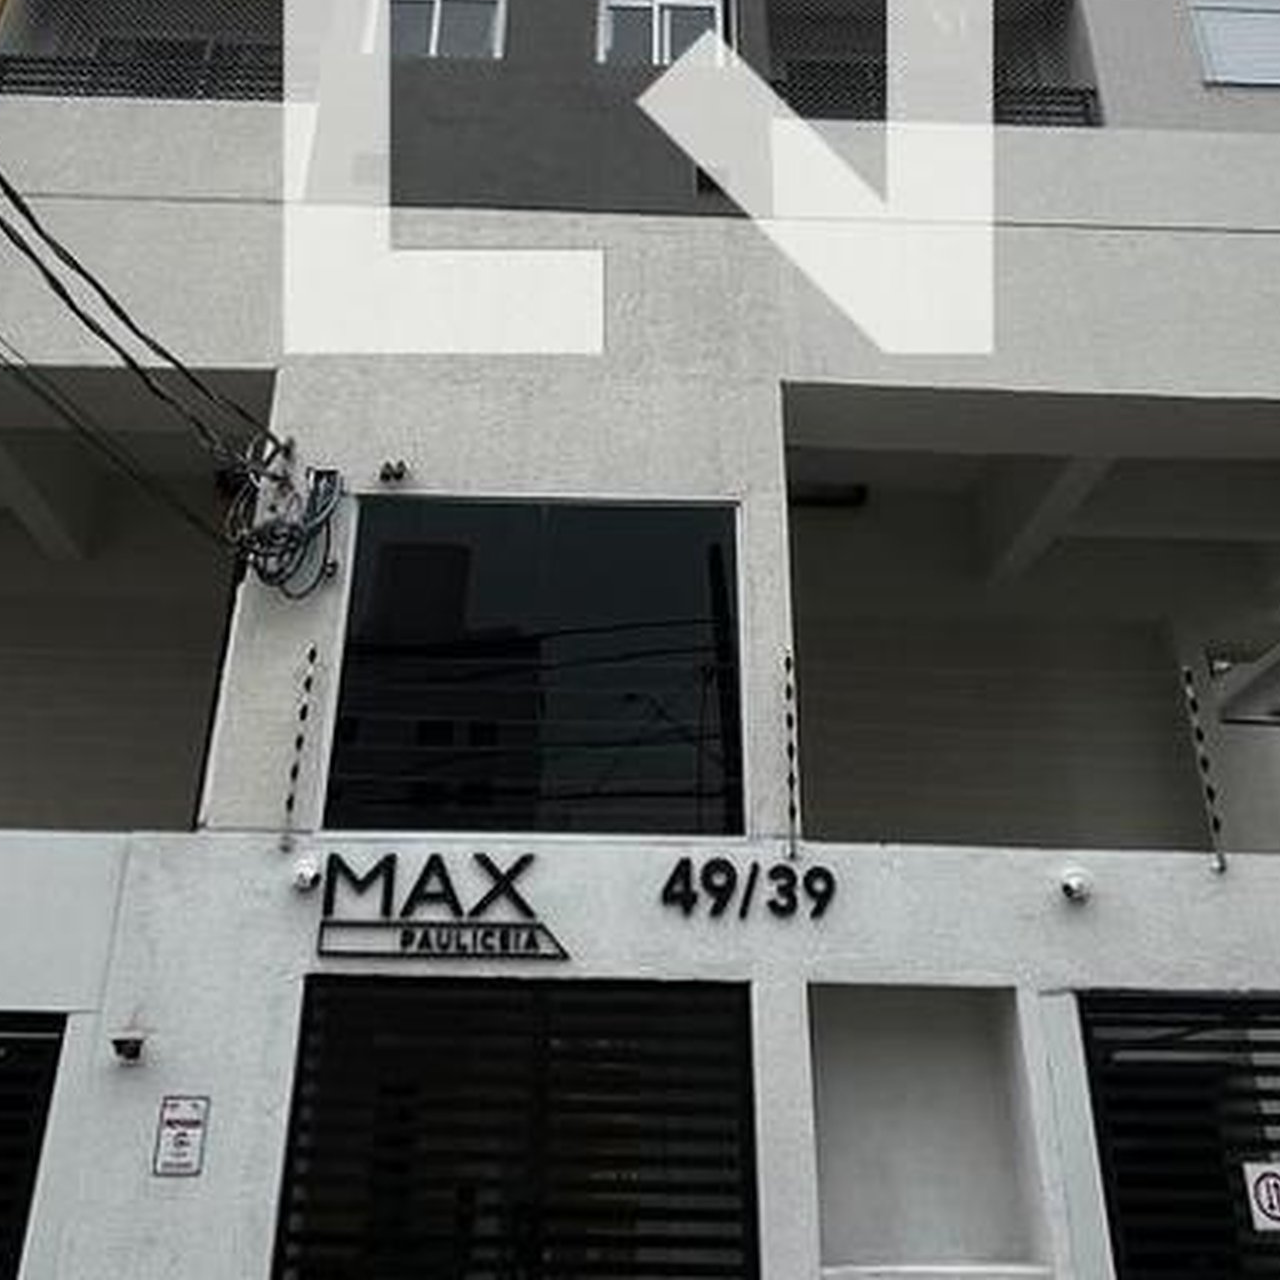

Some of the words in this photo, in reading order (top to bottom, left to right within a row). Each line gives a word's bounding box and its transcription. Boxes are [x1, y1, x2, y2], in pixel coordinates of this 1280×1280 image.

[322, 851, 537, 919] MAX
[660, 856, 837, 920] 49/39
[400, 928, 541, 951] PAULICEIA
